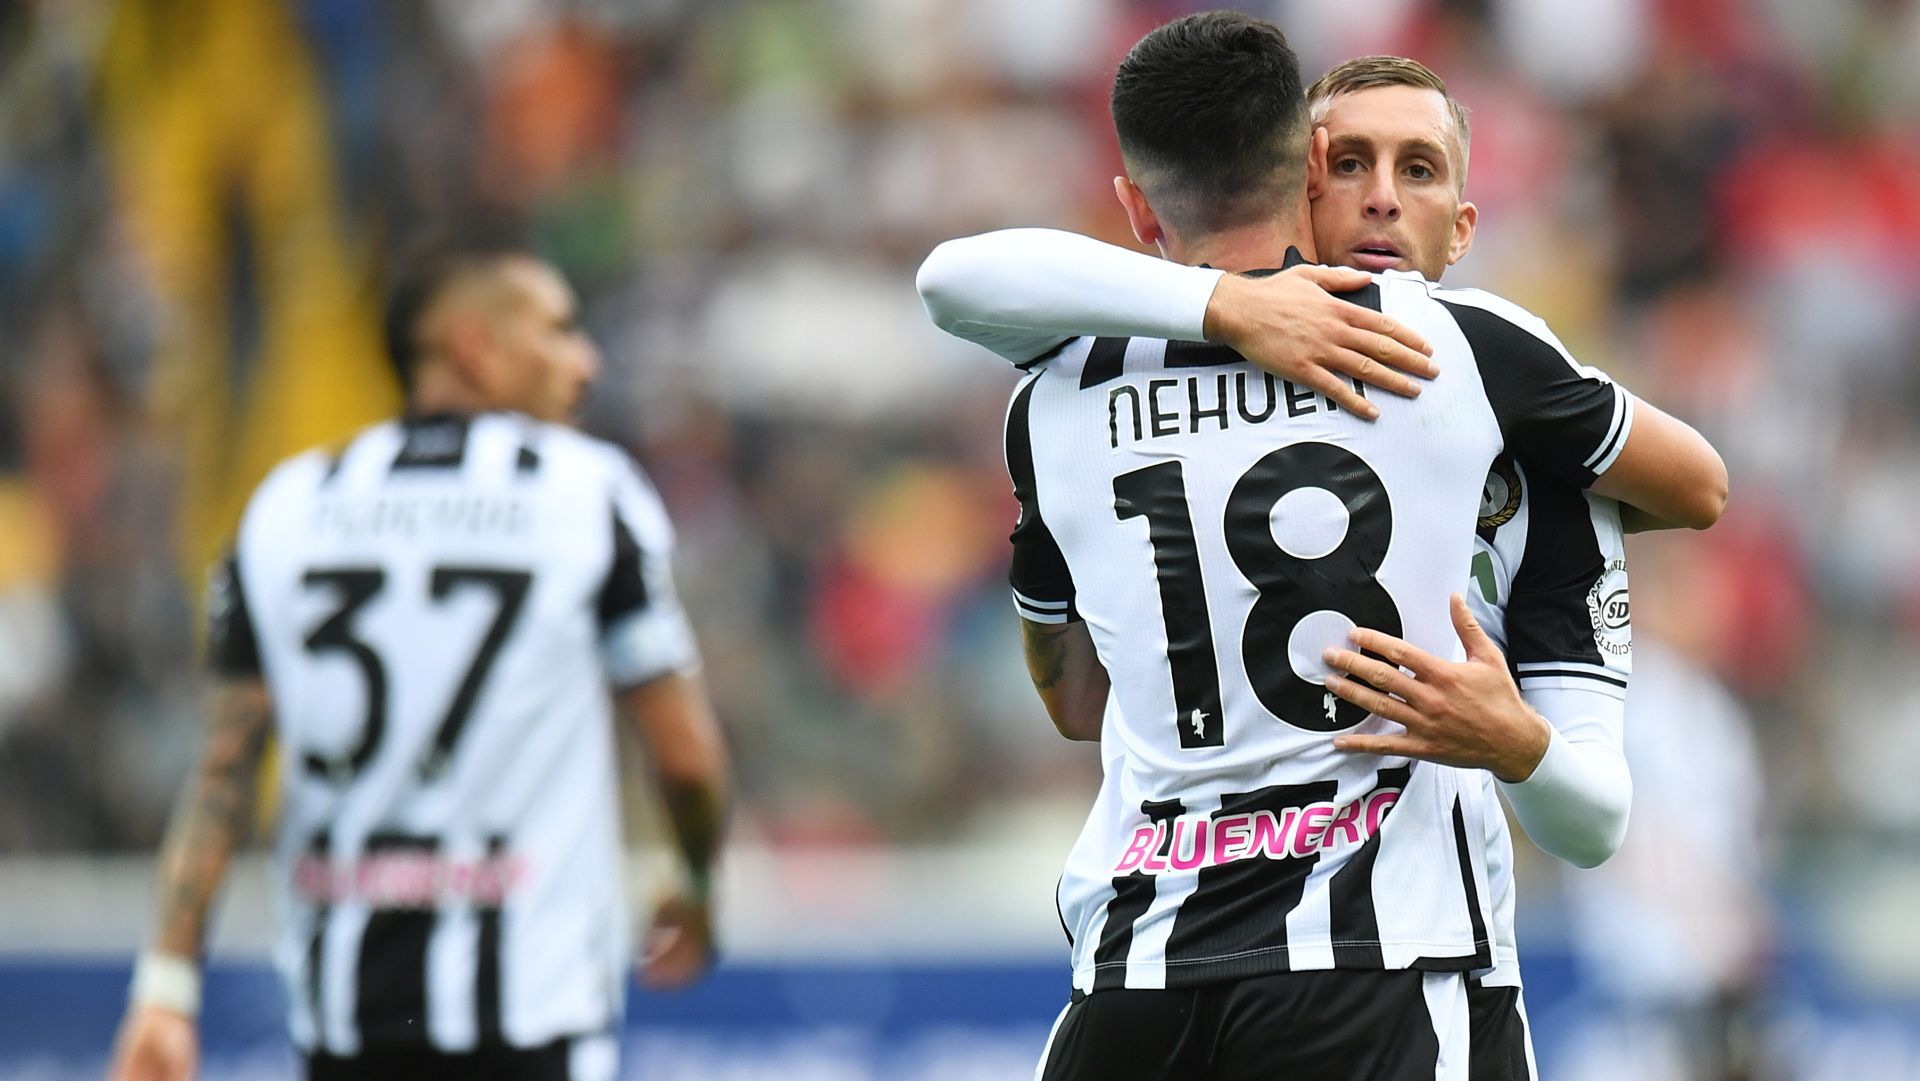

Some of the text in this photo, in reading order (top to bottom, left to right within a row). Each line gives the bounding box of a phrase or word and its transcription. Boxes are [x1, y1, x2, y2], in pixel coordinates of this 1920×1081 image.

[301, 566, 534, 785] 37
[1112, 440, 1405, 750] 18
[1607, 601, 1630, 619] SD
